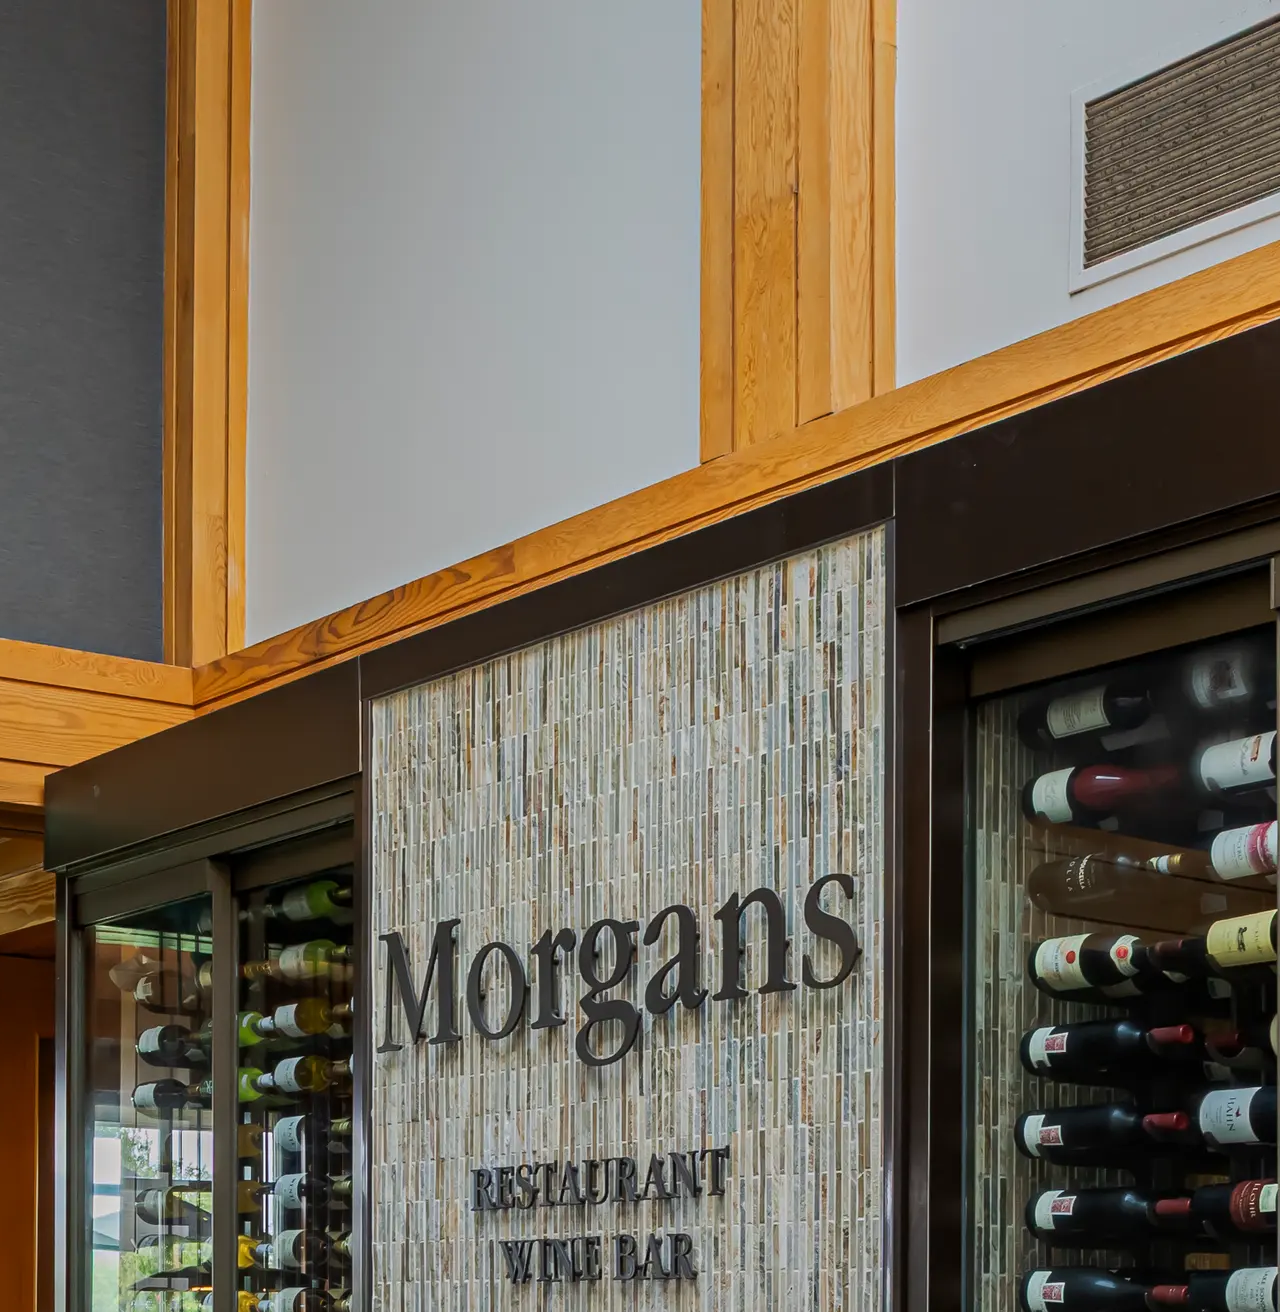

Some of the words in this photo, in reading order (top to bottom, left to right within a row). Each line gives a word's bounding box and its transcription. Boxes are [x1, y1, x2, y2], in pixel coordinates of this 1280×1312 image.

[377, 873, 862, 1066] Morgans
[1226, 1098, 1237, 1132] HAHN
[471, 1146, 730, 1211] RESTAURANT
[499, 1235, 602, 1284] WINE
[613, 1232, 697, 1281] BAR
